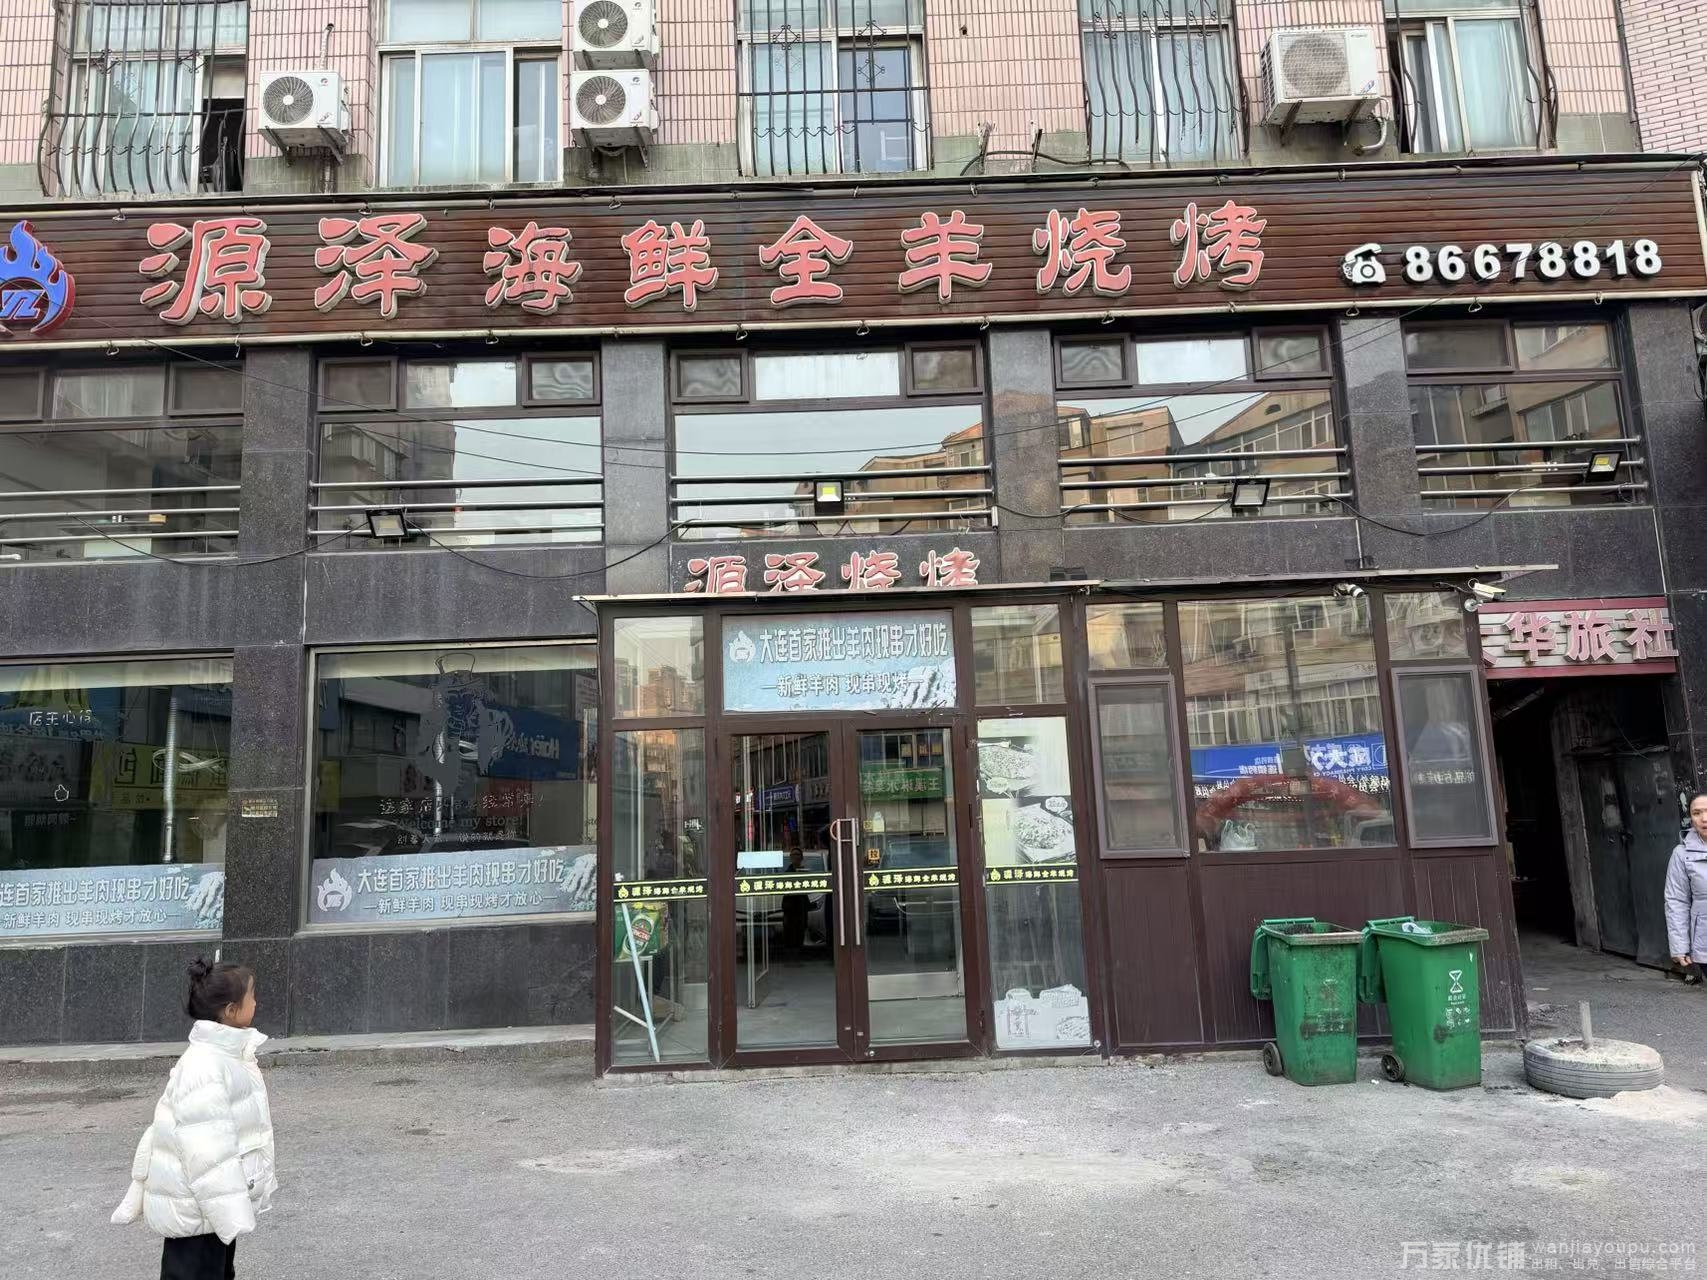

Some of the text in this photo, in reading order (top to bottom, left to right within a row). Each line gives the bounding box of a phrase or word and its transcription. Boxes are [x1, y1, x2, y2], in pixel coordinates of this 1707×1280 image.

[138, 200, 1268, 326] 源泽海鲜全羊烧烤
[1404, 238, 1663, 283] 86678818
[759, 622, 948, 664] 大连首家推出羊肉现串才好吃
[1481, 608, 1679, 666] 华旅社
[776, 673, 841, 697] 新鲜羊肉
[0, 875, 190, 909] 连首家推出羊肉现串才好吃
[357, 859, 566, 894] 大连首家推出羊肉现串才好吃
[4, 906, 167, 930] 新鲜羊肉 现串现烤才放心
[377, 886, 543, 915] 新鲜羊肉 现串现烤才放心
